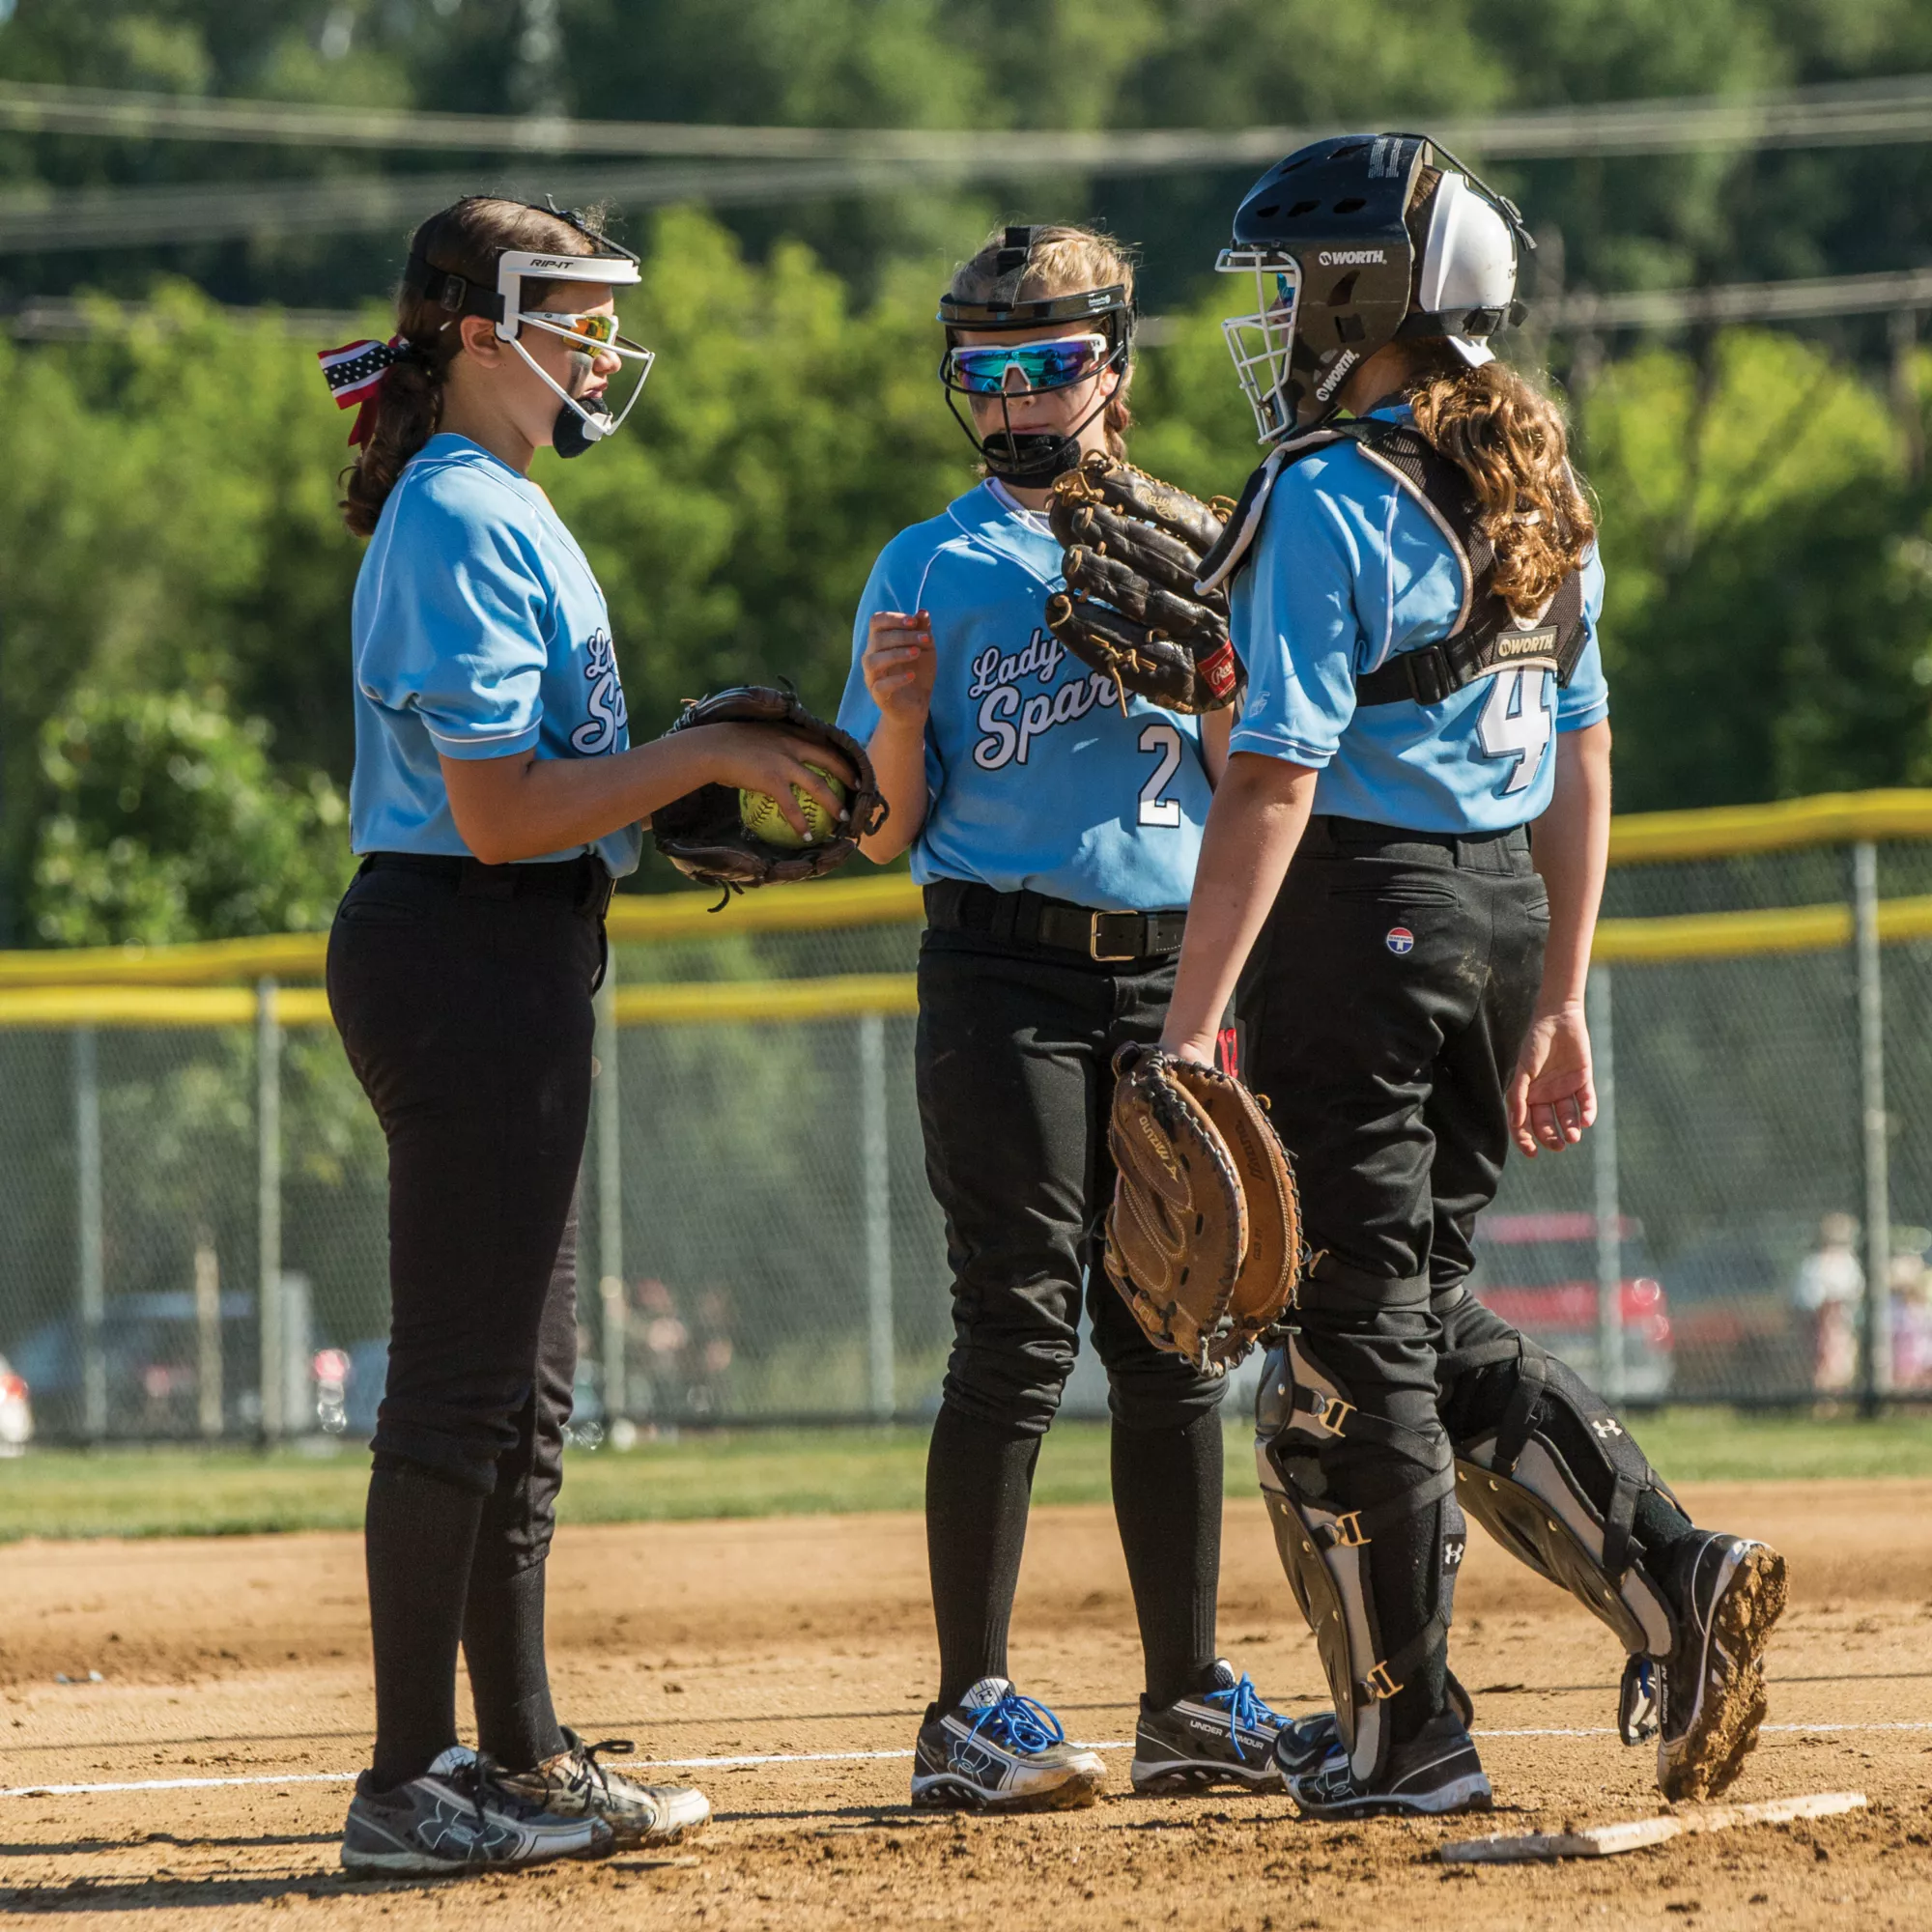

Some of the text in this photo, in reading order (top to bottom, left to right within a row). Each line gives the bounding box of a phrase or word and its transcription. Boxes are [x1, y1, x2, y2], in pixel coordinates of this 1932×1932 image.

[529, 258, 574, 270] RIP-IT
[1332, 249, 1384, 265] WORTH
[1322, 349, 1356, 392] WORTH
[1510, 633, 1554, 655] WORTH
[968, 627, 1065, 699] Lady
[1476, 666, 1552, 796] 4
[1137, 723, 1182, 829] 2
[1190, 1720, 1223, 1736] UNDER
